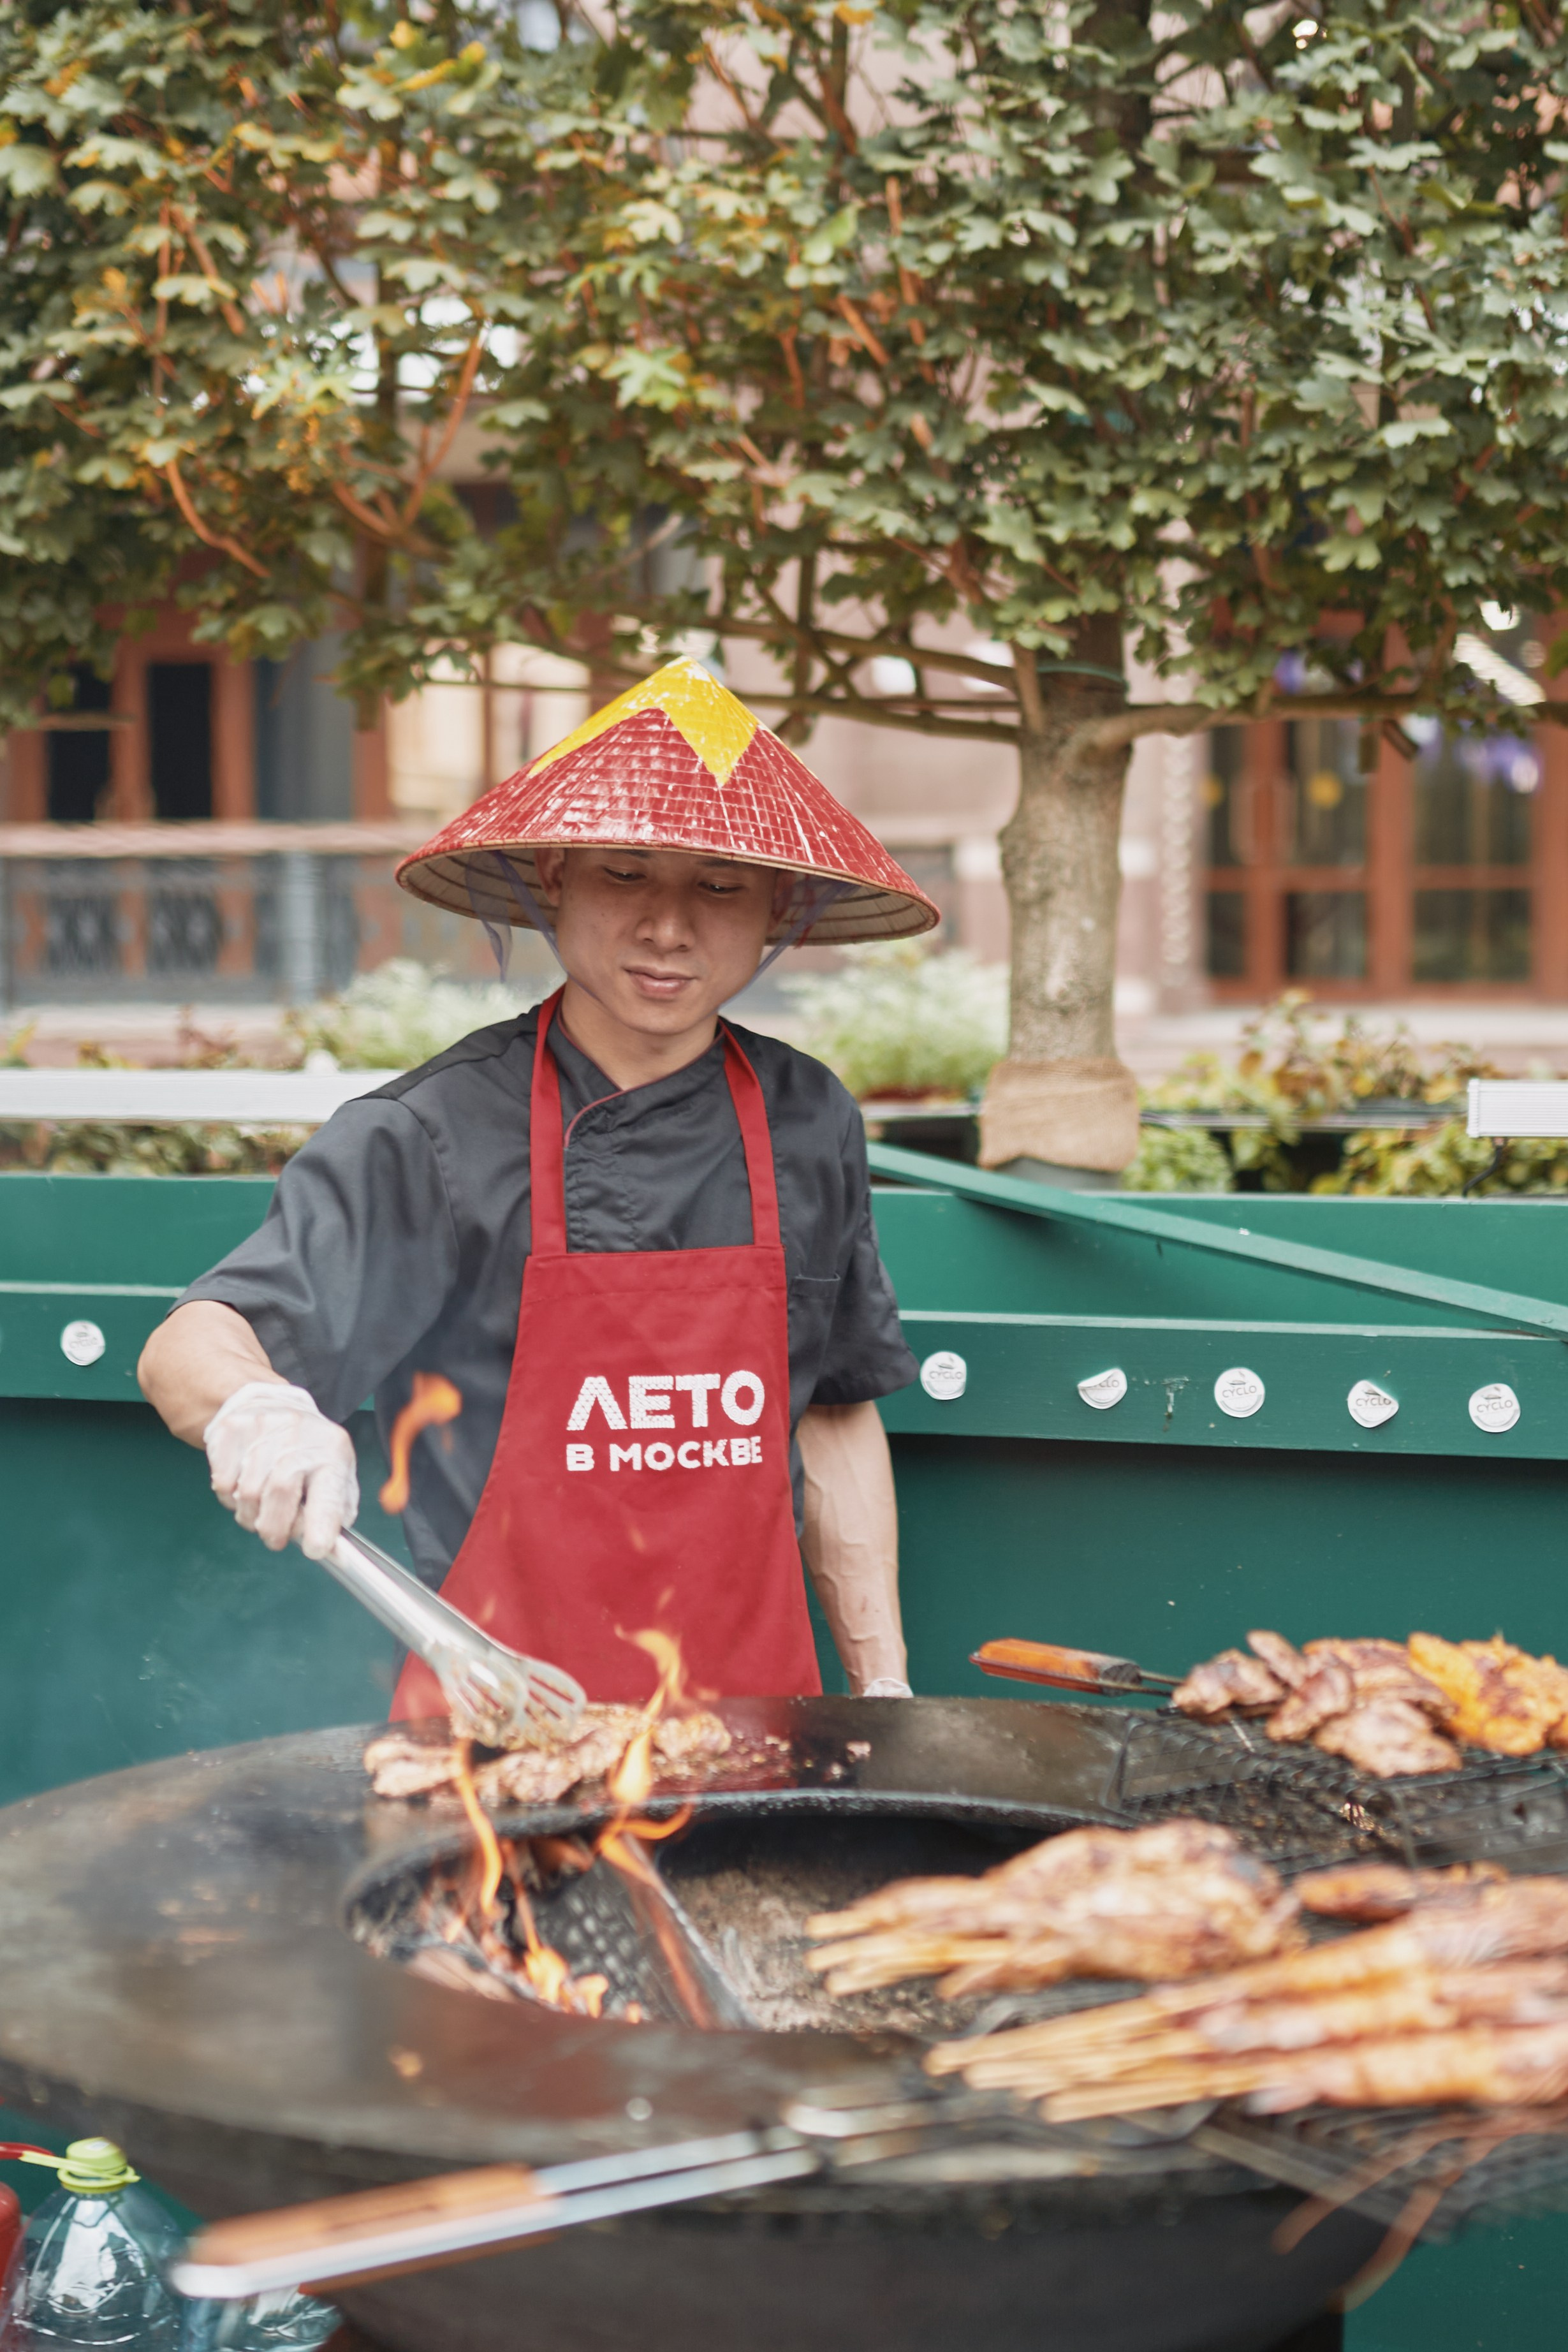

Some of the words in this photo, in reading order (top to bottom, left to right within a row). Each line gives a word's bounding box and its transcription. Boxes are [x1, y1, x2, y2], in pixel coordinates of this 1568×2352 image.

[929, 1371, 963, 1380] CYCLO
[1094, 1379, 1120, 1388] CLO
[1222, 1385, 1257, 1398] CYCLO
[566, 1370, 765, 1430] ЛЕТО
[1356, 1397, 1391, 1406] CYCLO
[1476, 1400, 1513, 1413] CYCLO
[566, 1443, 595, 1471] В
[610, 1436, 763, 1471] МОСКВЕ
